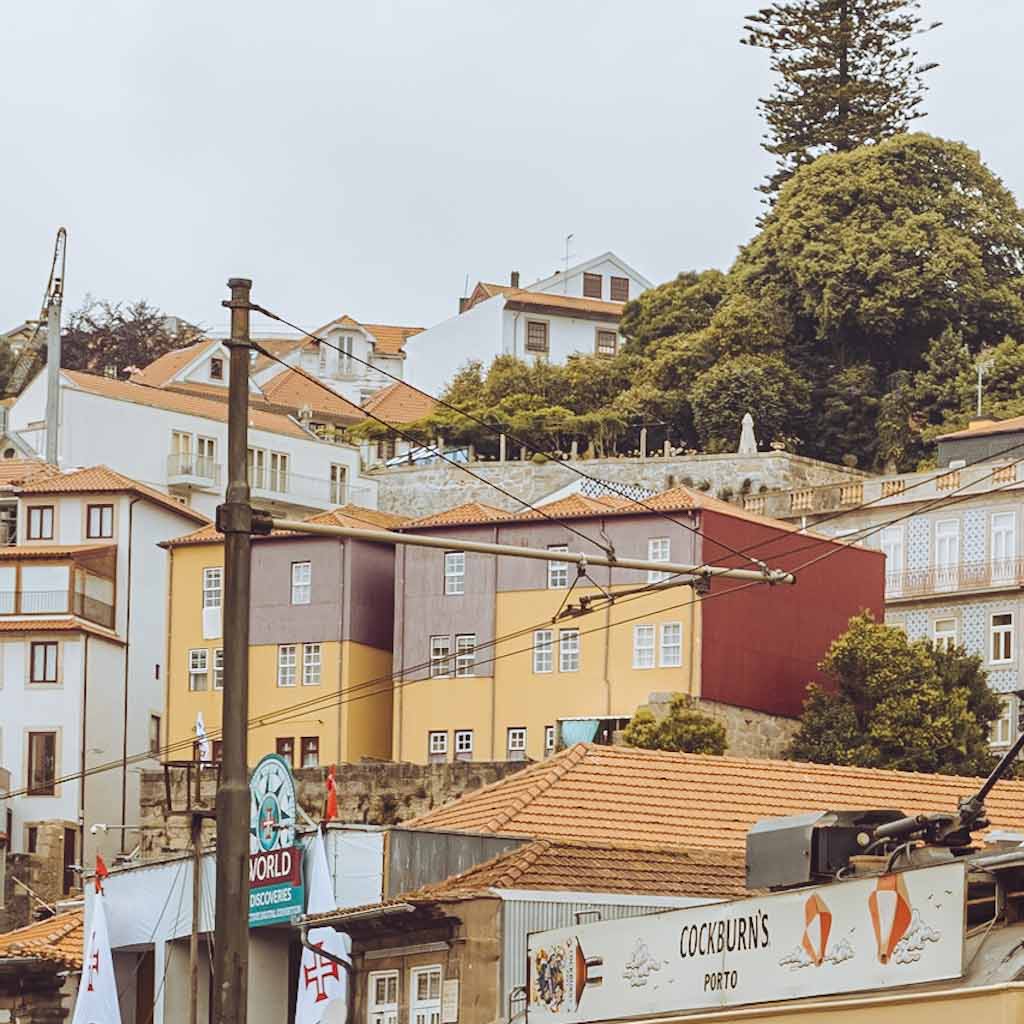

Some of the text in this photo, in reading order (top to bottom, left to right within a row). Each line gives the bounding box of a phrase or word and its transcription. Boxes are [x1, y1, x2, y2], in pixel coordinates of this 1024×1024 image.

[250, 888, 291, 907] DISCOVERIES
[680, 909, 769, 958] COCKBURN'S
[703, 970, 738, 992] PORTO
